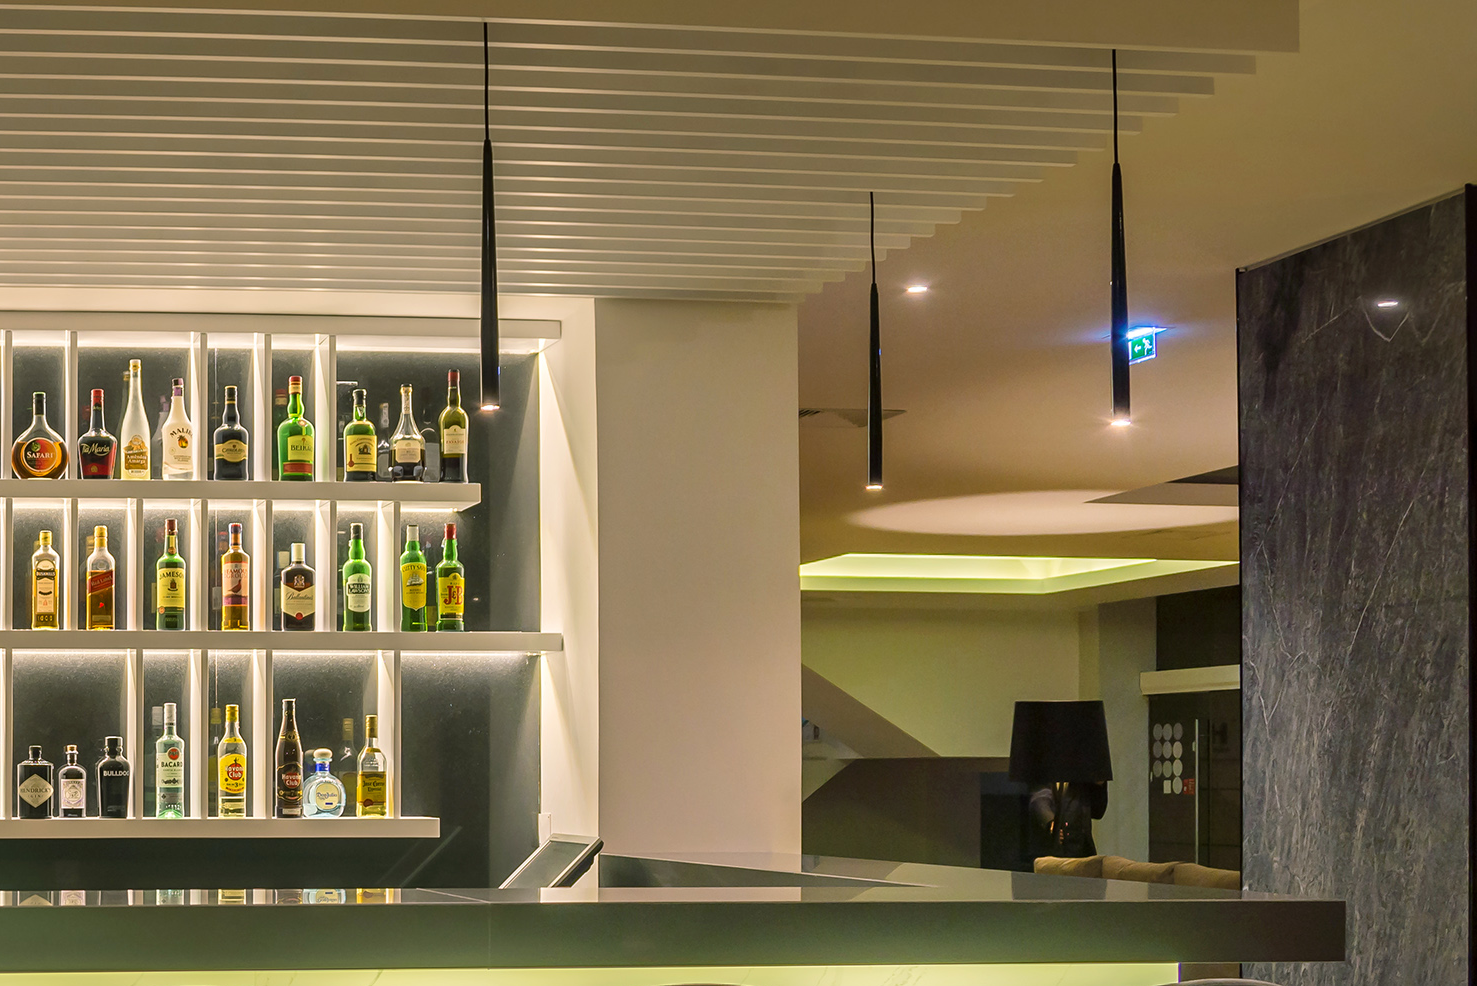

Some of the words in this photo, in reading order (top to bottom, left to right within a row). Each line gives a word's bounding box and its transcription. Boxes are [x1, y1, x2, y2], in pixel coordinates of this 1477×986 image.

[26, 451, 55, 460] SAFARI
[80, 443, 92, 455] Tia
[90, 443, 111, 457] Maria
[158, 570, 184, 580] JAMESO
[443, 585, 464, 606] J&B
